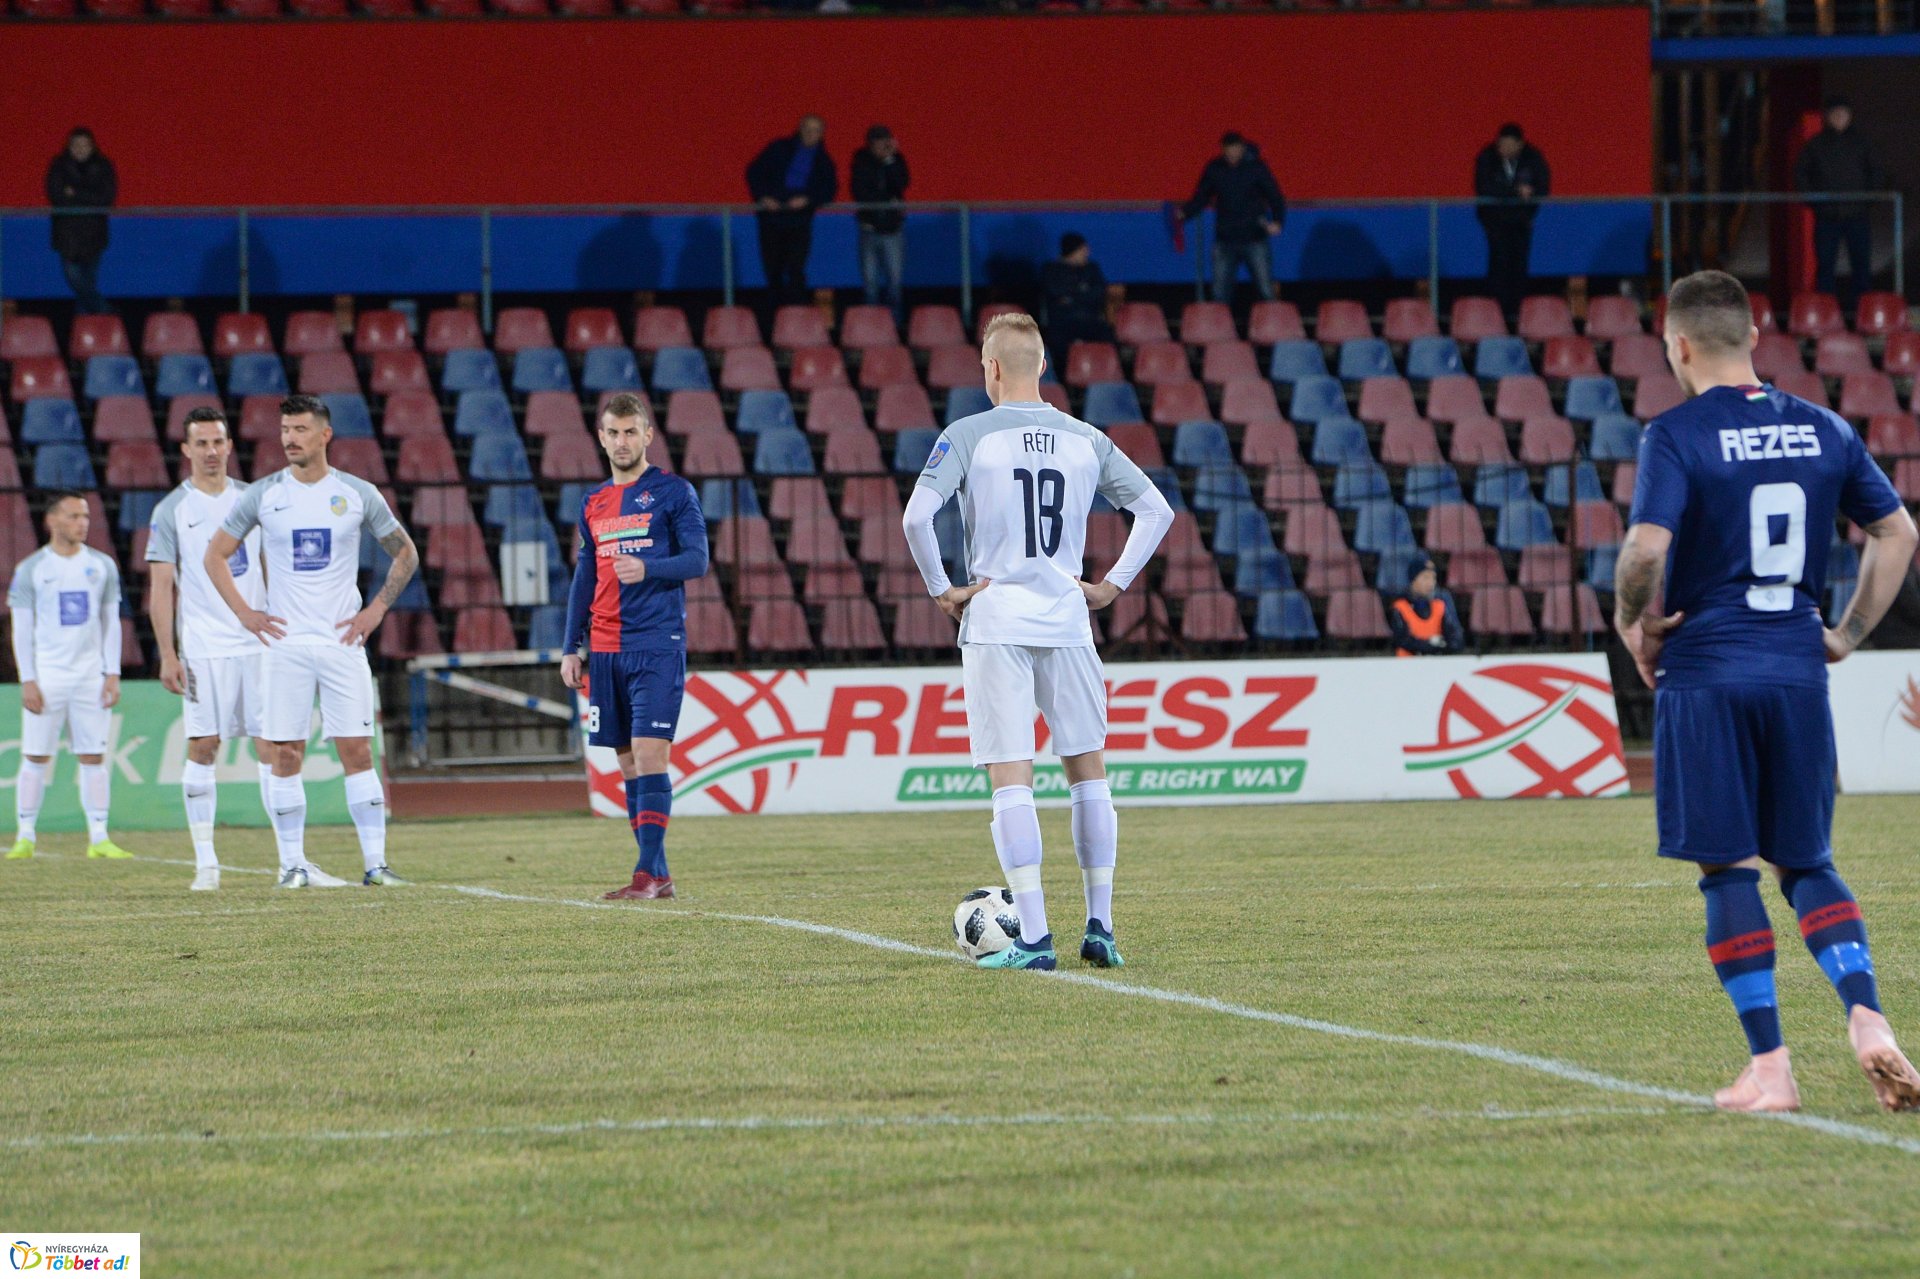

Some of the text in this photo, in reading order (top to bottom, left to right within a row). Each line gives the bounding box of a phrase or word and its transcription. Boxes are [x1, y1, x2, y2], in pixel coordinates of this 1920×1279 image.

[1023, 429, 1055, 455] RÉTI
[1718, 425, 1822, 462] REZES
[1013, 468, 1065, 558] 18
[1745, 482, 1807, 611] 9
[819, 676, 1318, 757] REESZ
[906, 773, 986, 794] ALWA
[1138, 768, 1226, 789] RIGHT
[1232, 767, 1299, 788] WAY
